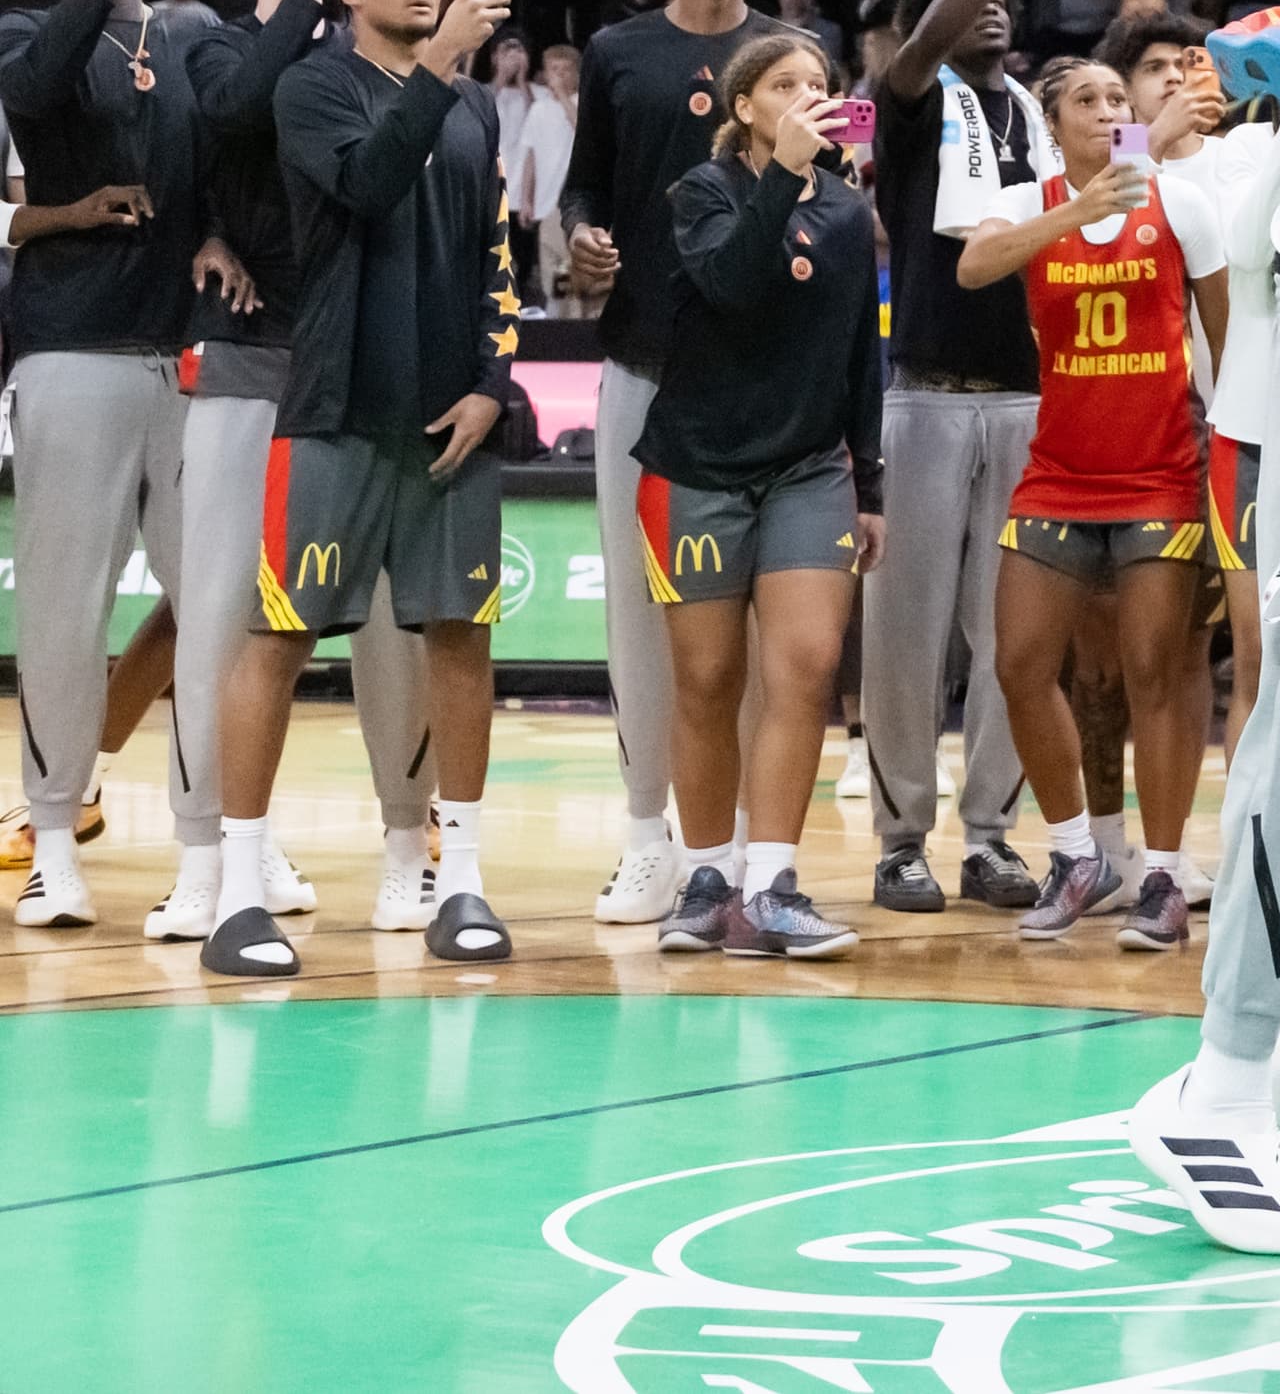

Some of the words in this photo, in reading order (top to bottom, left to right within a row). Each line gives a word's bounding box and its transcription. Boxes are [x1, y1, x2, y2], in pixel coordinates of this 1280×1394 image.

[957, 90, 983, 178] POWERADE
[1074, 291, 1128, 350] 10
[1068, 351, 1167, 377] AMERICAN
